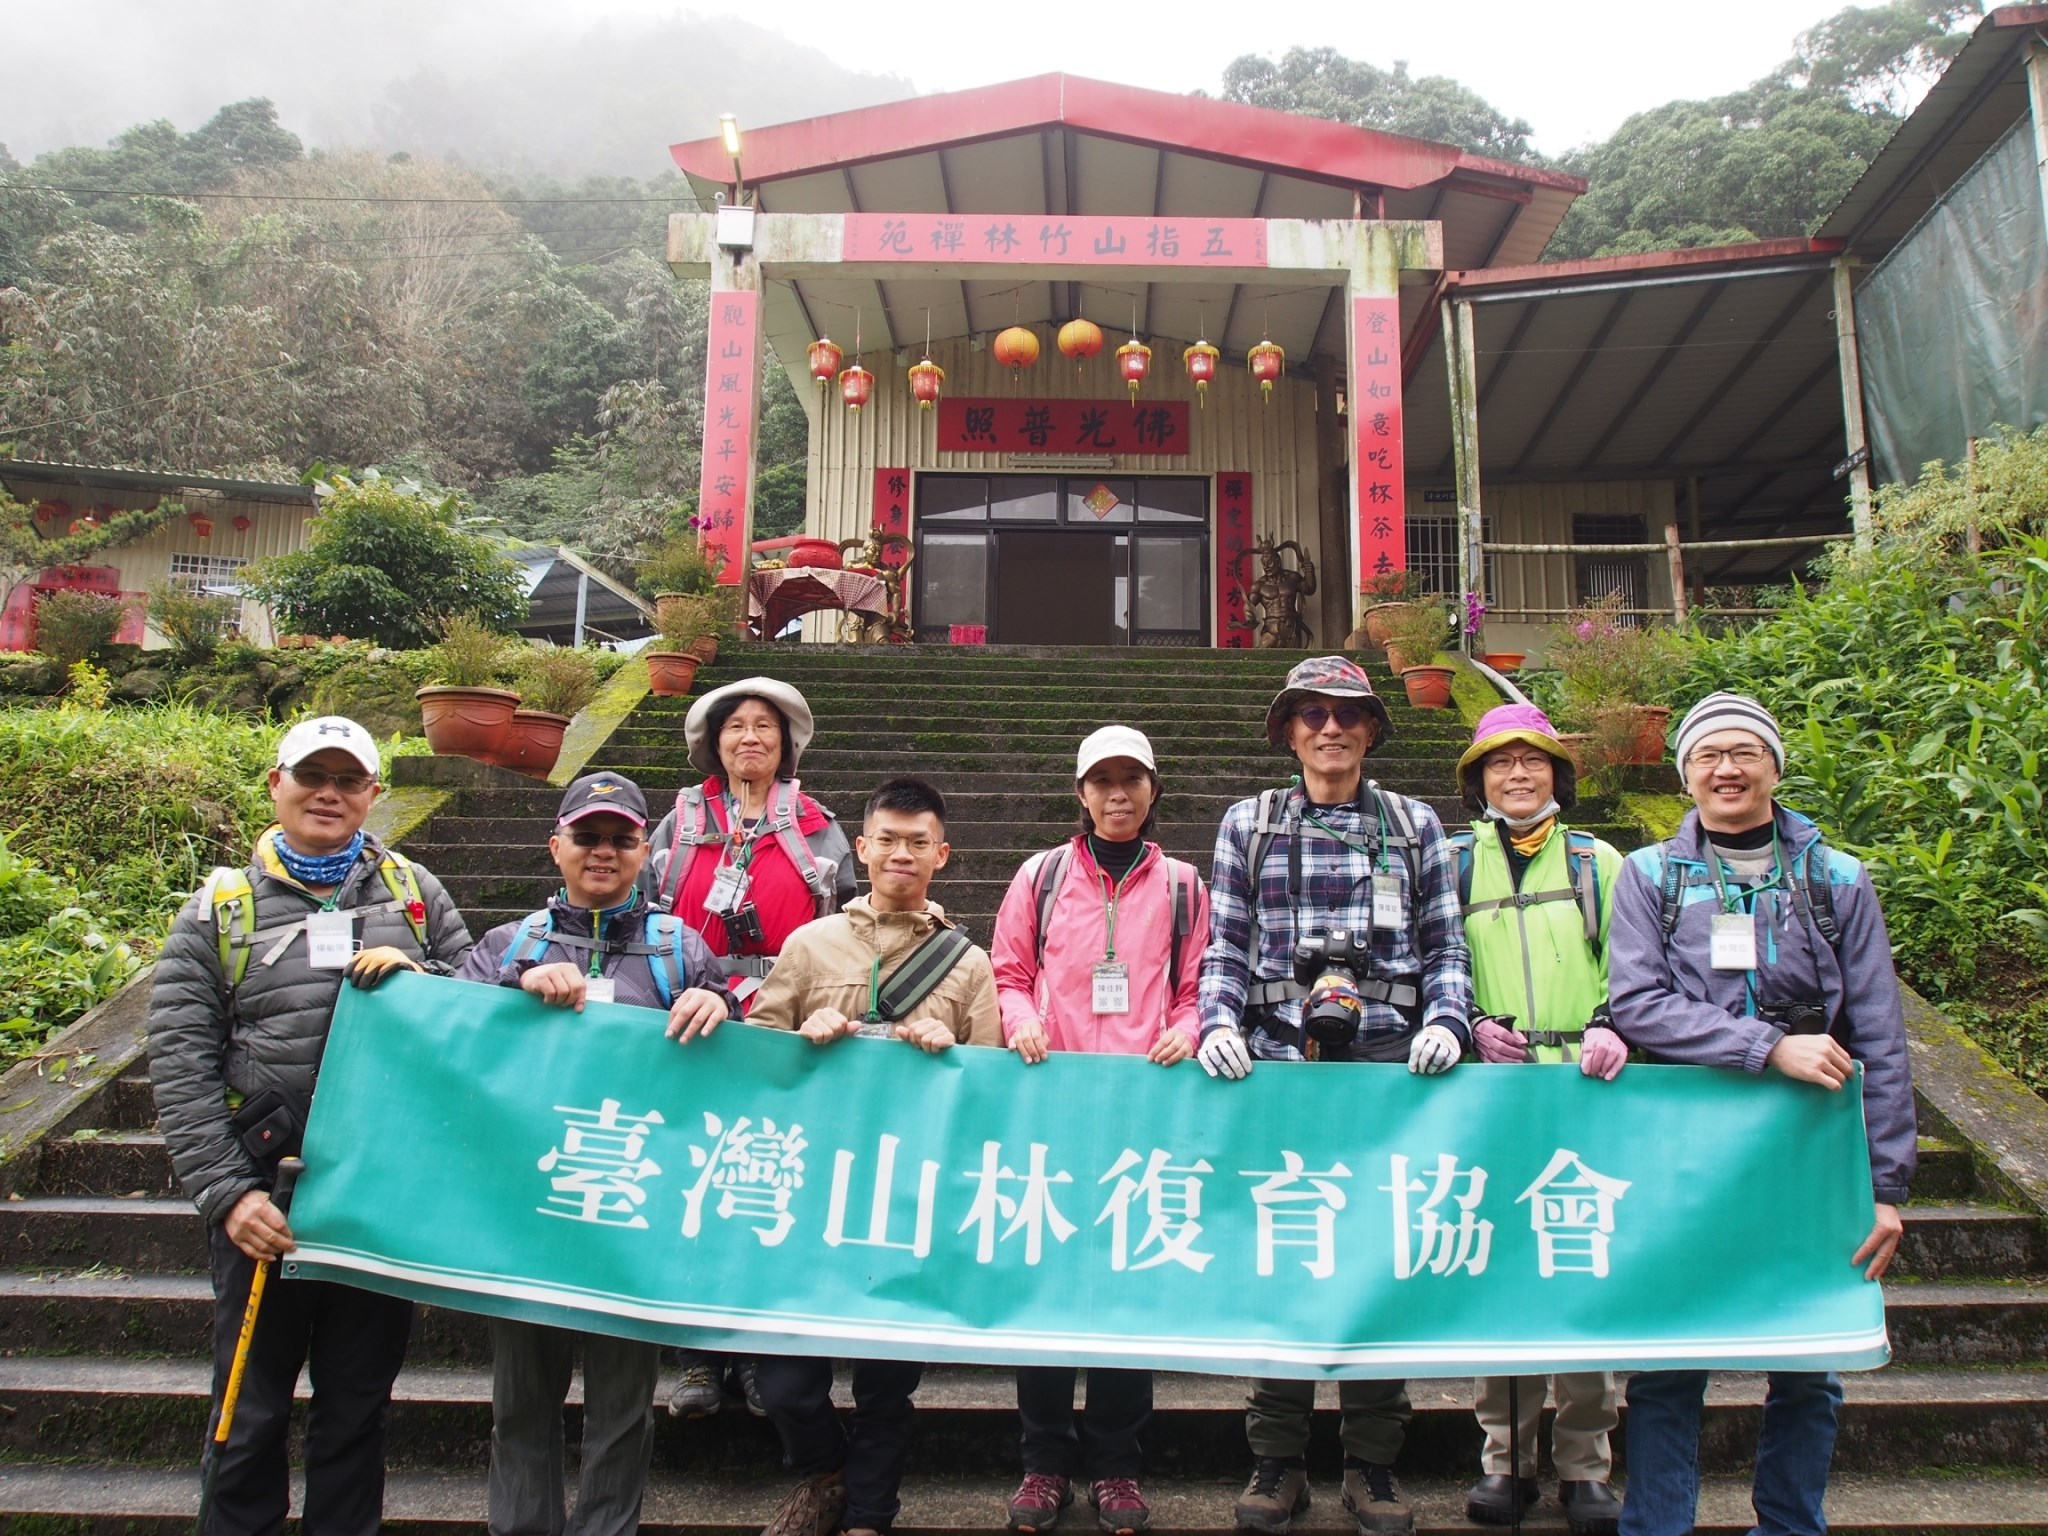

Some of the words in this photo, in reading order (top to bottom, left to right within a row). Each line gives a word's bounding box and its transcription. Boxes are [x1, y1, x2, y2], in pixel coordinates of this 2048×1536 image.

[877, 220, 1233, 259] 五指山竹林禪苑
[961, 406, 1176, 448] 佛光普照
[1365, 312, 1394, 575] 登山如意吃杯茶去
[536, 1096, 1633, 1280] 臺灣山林復育協會
